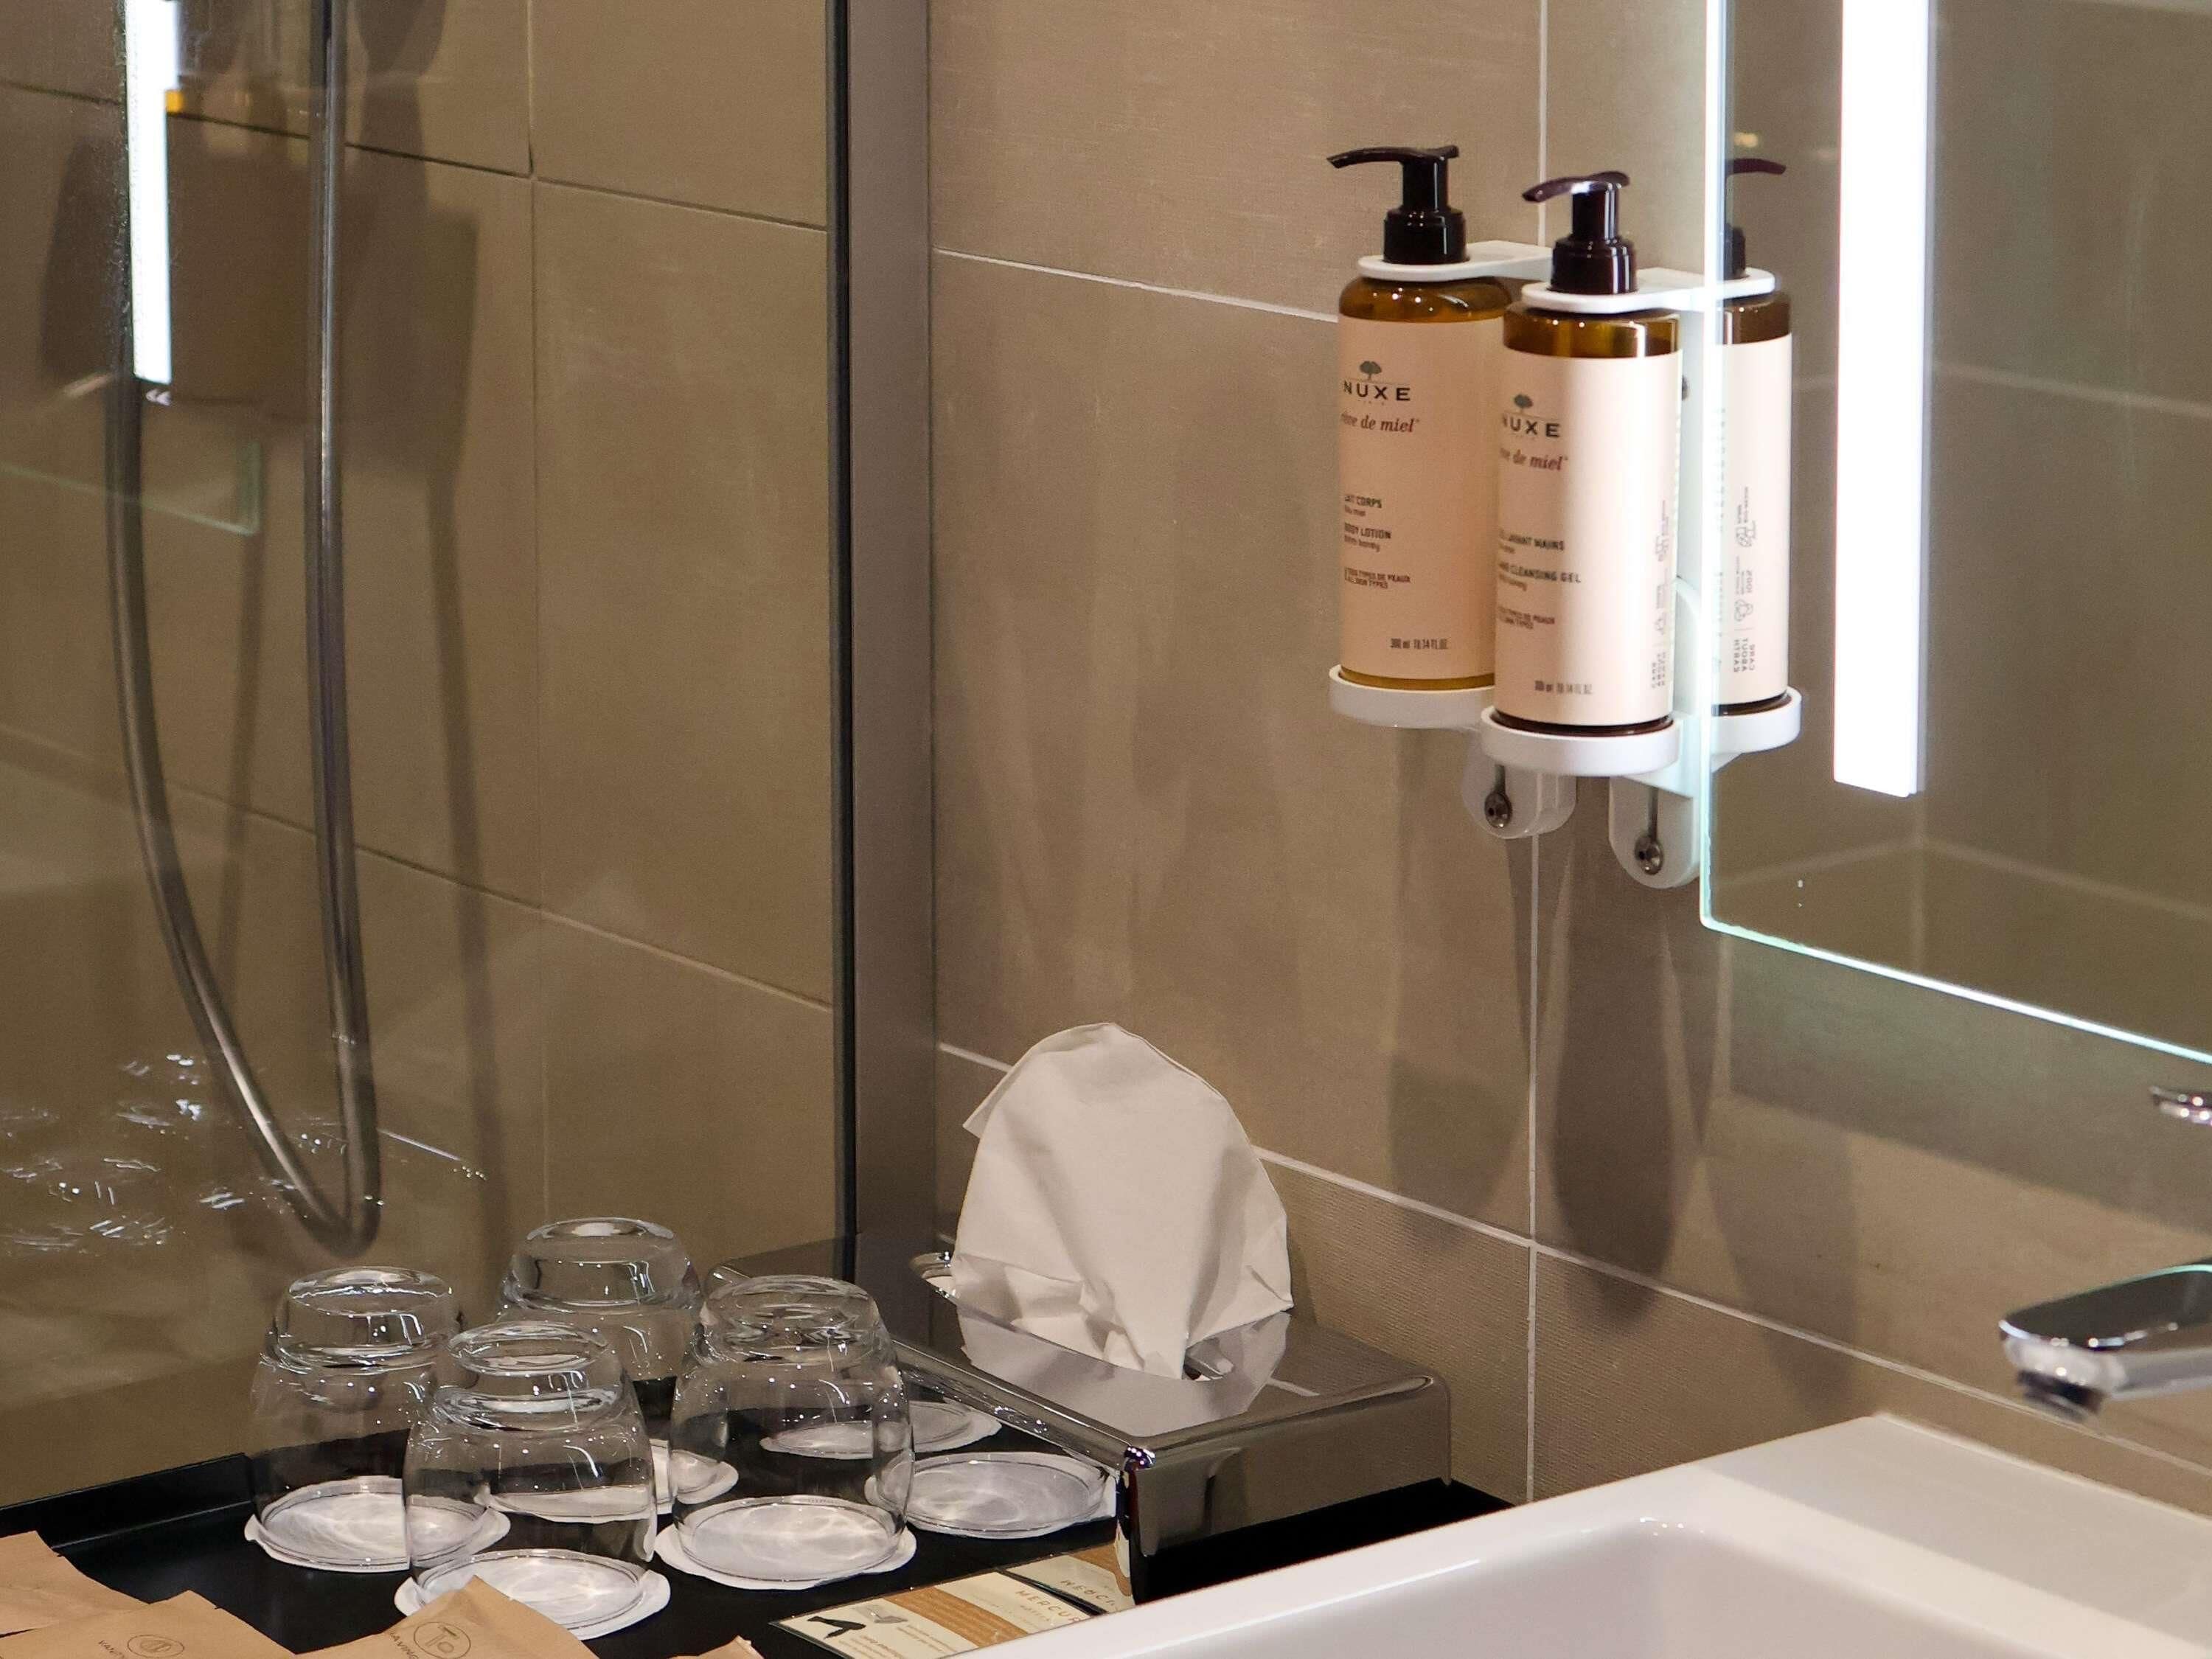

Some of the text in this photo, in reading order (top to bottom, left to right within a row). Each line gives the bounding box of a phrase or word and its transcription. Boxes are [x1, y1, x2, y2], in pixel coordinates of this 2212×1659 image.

[1343, 380, 1411, 401] NUXE
[1360, 414, 1376, 430] de
[1360, 527, 1392, 540] LOTION
[1560, 572, 1581, 583] GEL
[1015, 1590, 1082, 1623] MERCUR
